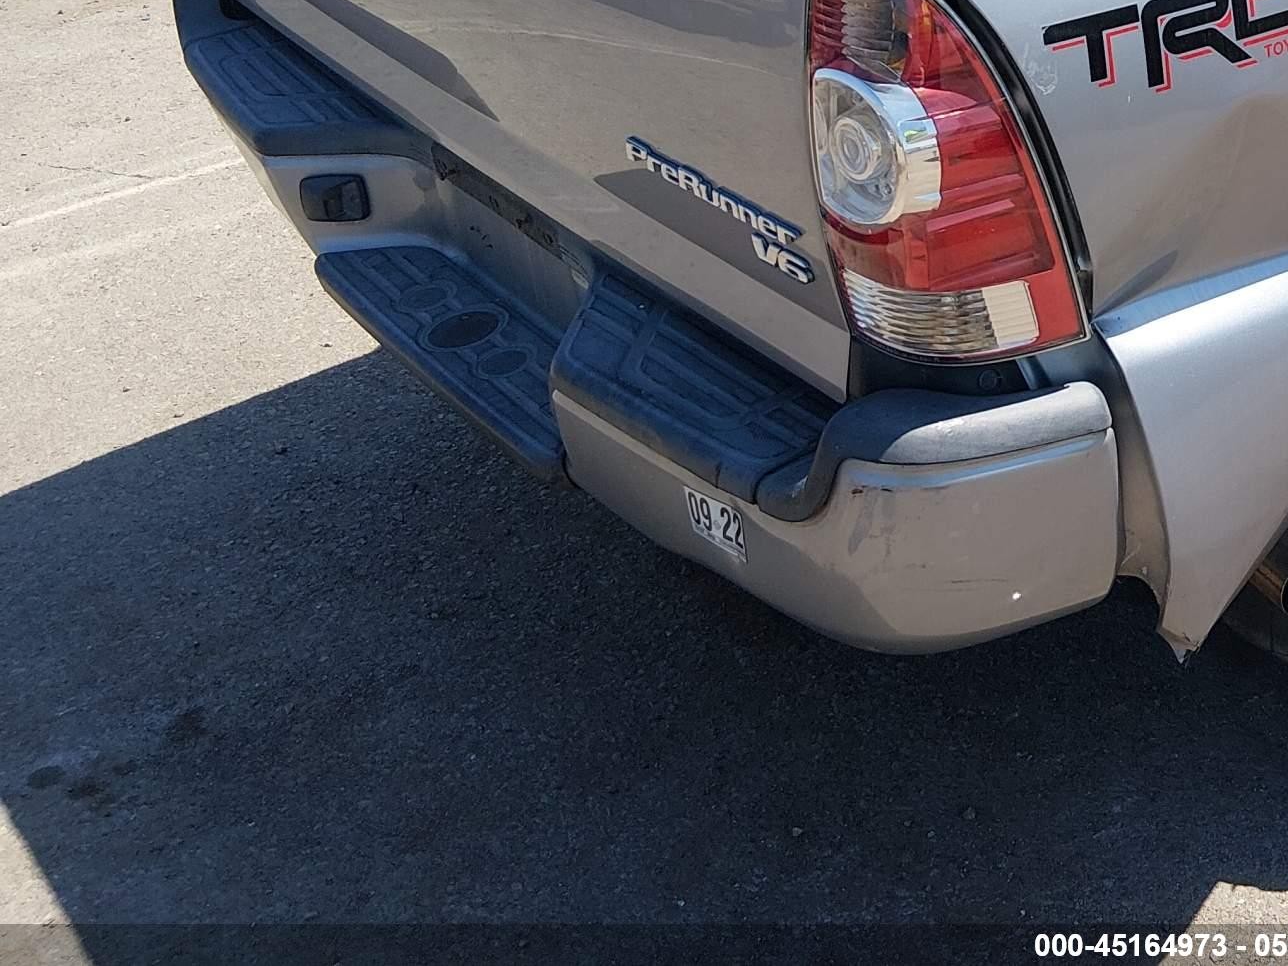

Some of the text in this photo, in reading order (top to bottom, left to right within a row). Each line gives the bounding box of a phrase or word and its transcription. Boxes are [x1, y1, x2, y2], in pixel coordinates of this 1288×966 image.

[625, 136, 804, 245] PreRunner
[751, 231, 815, 285] V6
[687, 491, 744, 549] 09 22
